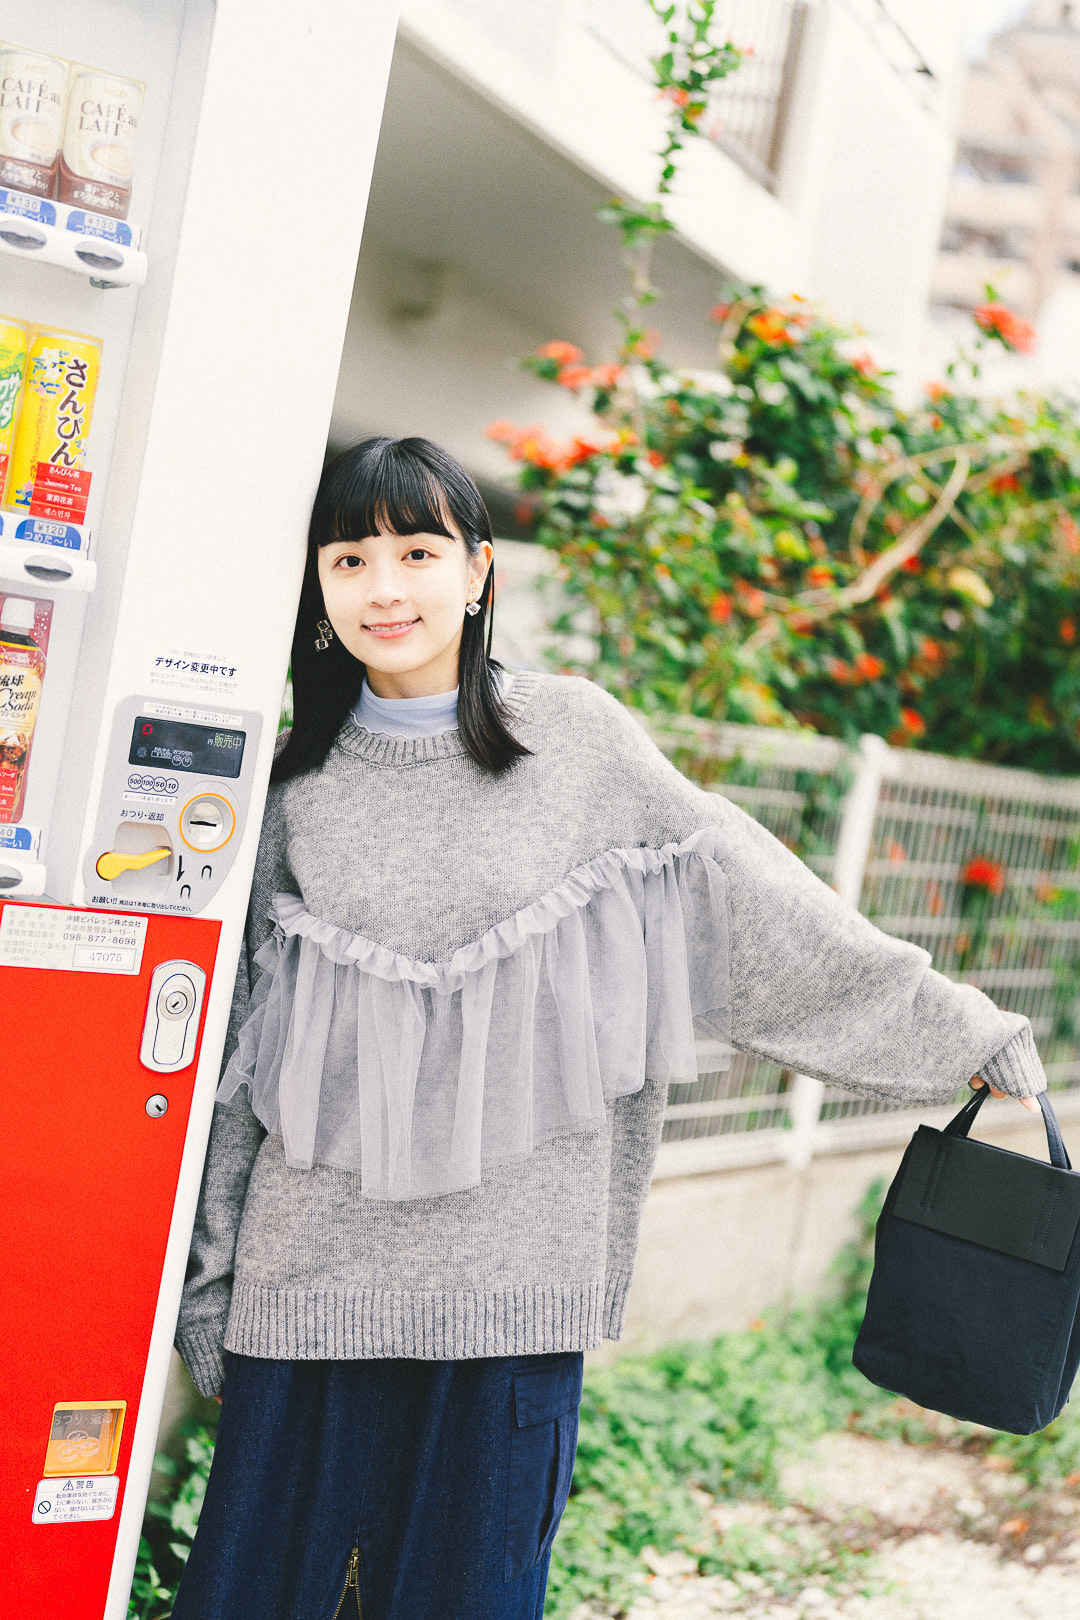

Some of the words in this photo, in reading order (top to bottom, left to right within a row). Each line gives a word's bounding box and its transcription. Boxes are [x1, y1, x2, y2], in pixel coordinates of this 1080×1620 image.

[2, 77, 48, 100] CAFÉ
[0, 93, 44, 113] LAIT
[80, 100, 128, 123] CAFÉ
[79, 116, 124, 136] LAIT
[11, 196, 38, 210] ¥130
[87, 218, 115, 231] ¥130
[50, 358, 88, 466] さんぴん
[45, 478, 69, 489] Jasmine
[71, 484, 82, 493] Tea
[37, 523, 65, 536] ¥120
[155, 657, 237, 677] デザイン変更中です
[5, 699, 34, 712] Soda
[214, 733, 242, 749] 販売中
[129, 777, 142, 786] 500
[143, 779, 154, 787] 100
[120, 809, 165, 821] おつり・返却
[63, 932, 137, 946] 098-877-8698
[89, 952, 123, 963] 47075
[75, 1480, 94, 1489] 警告
